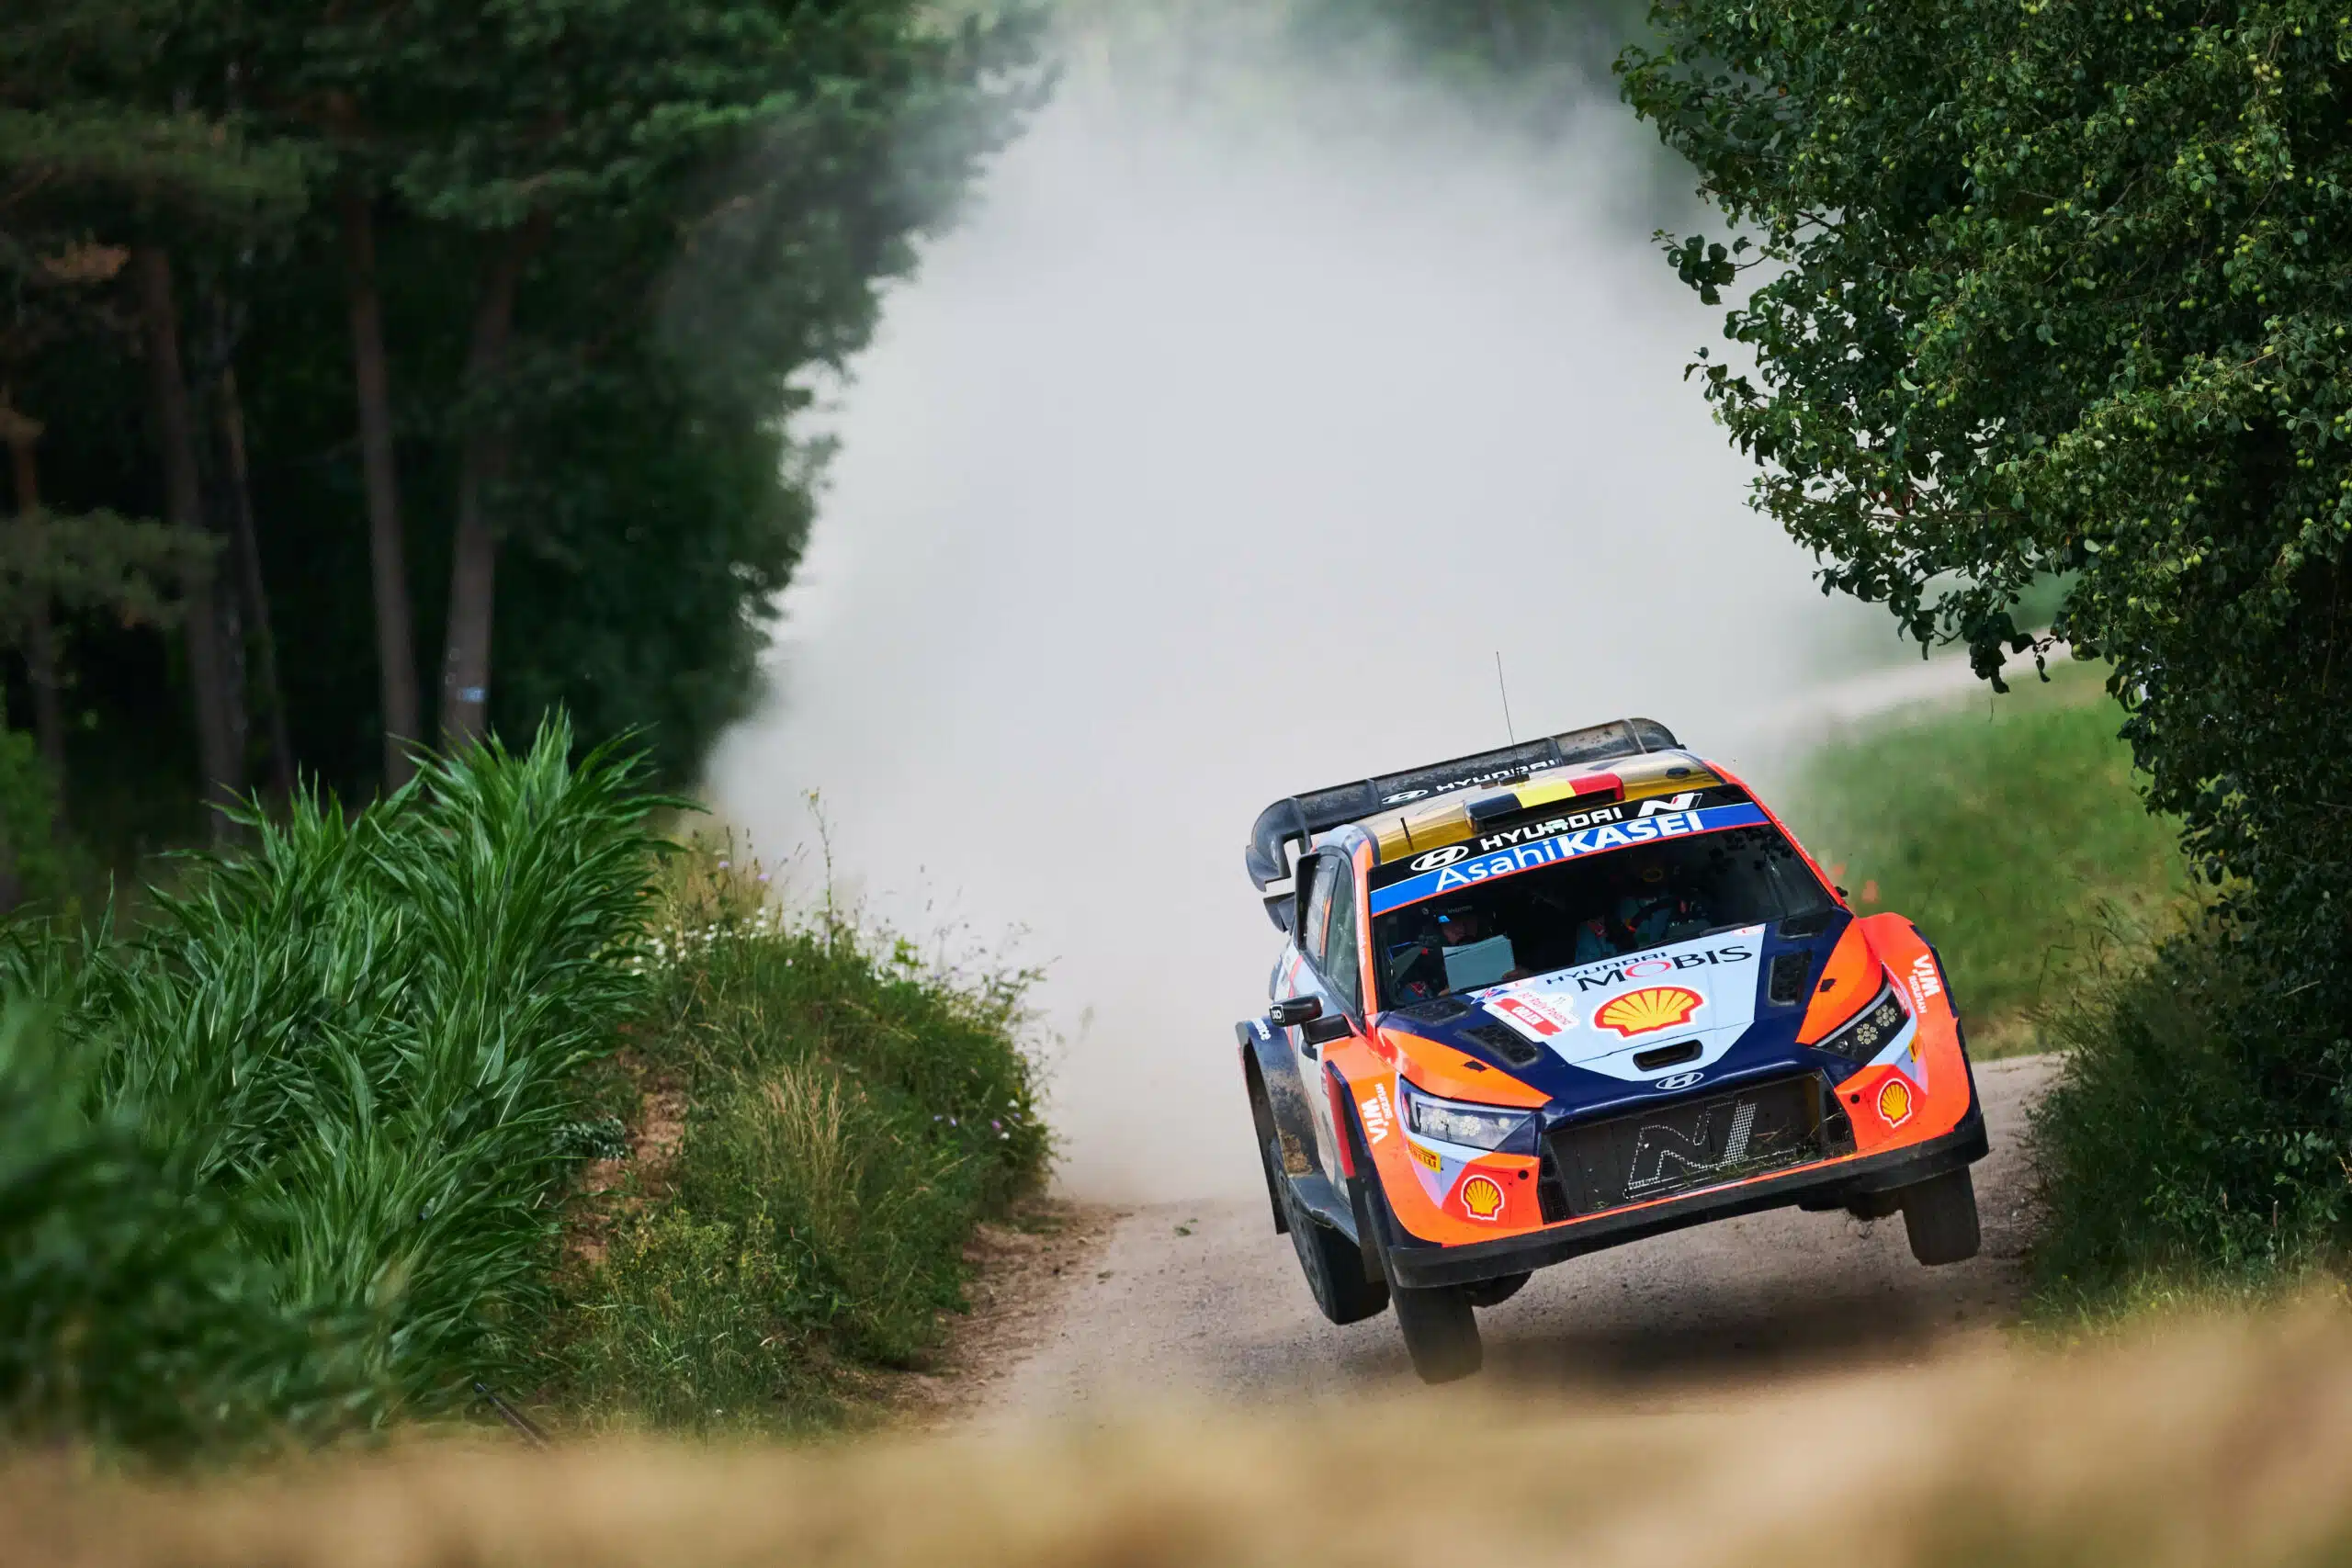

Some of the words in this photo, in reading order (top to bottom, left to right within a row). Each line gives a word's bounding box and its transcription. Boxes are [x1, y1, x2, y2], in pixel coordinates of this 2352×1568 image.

[1436, 758, 1557, 792] HYUNDAI
[1435, 811, 1705, 892] AsahiKASEI
[1479, 807, 1623, 852] HYUNDAI
[1545, 952, 1668, 985] HYUNDAI
[1577, 945, 1753, 992] MOBIS
